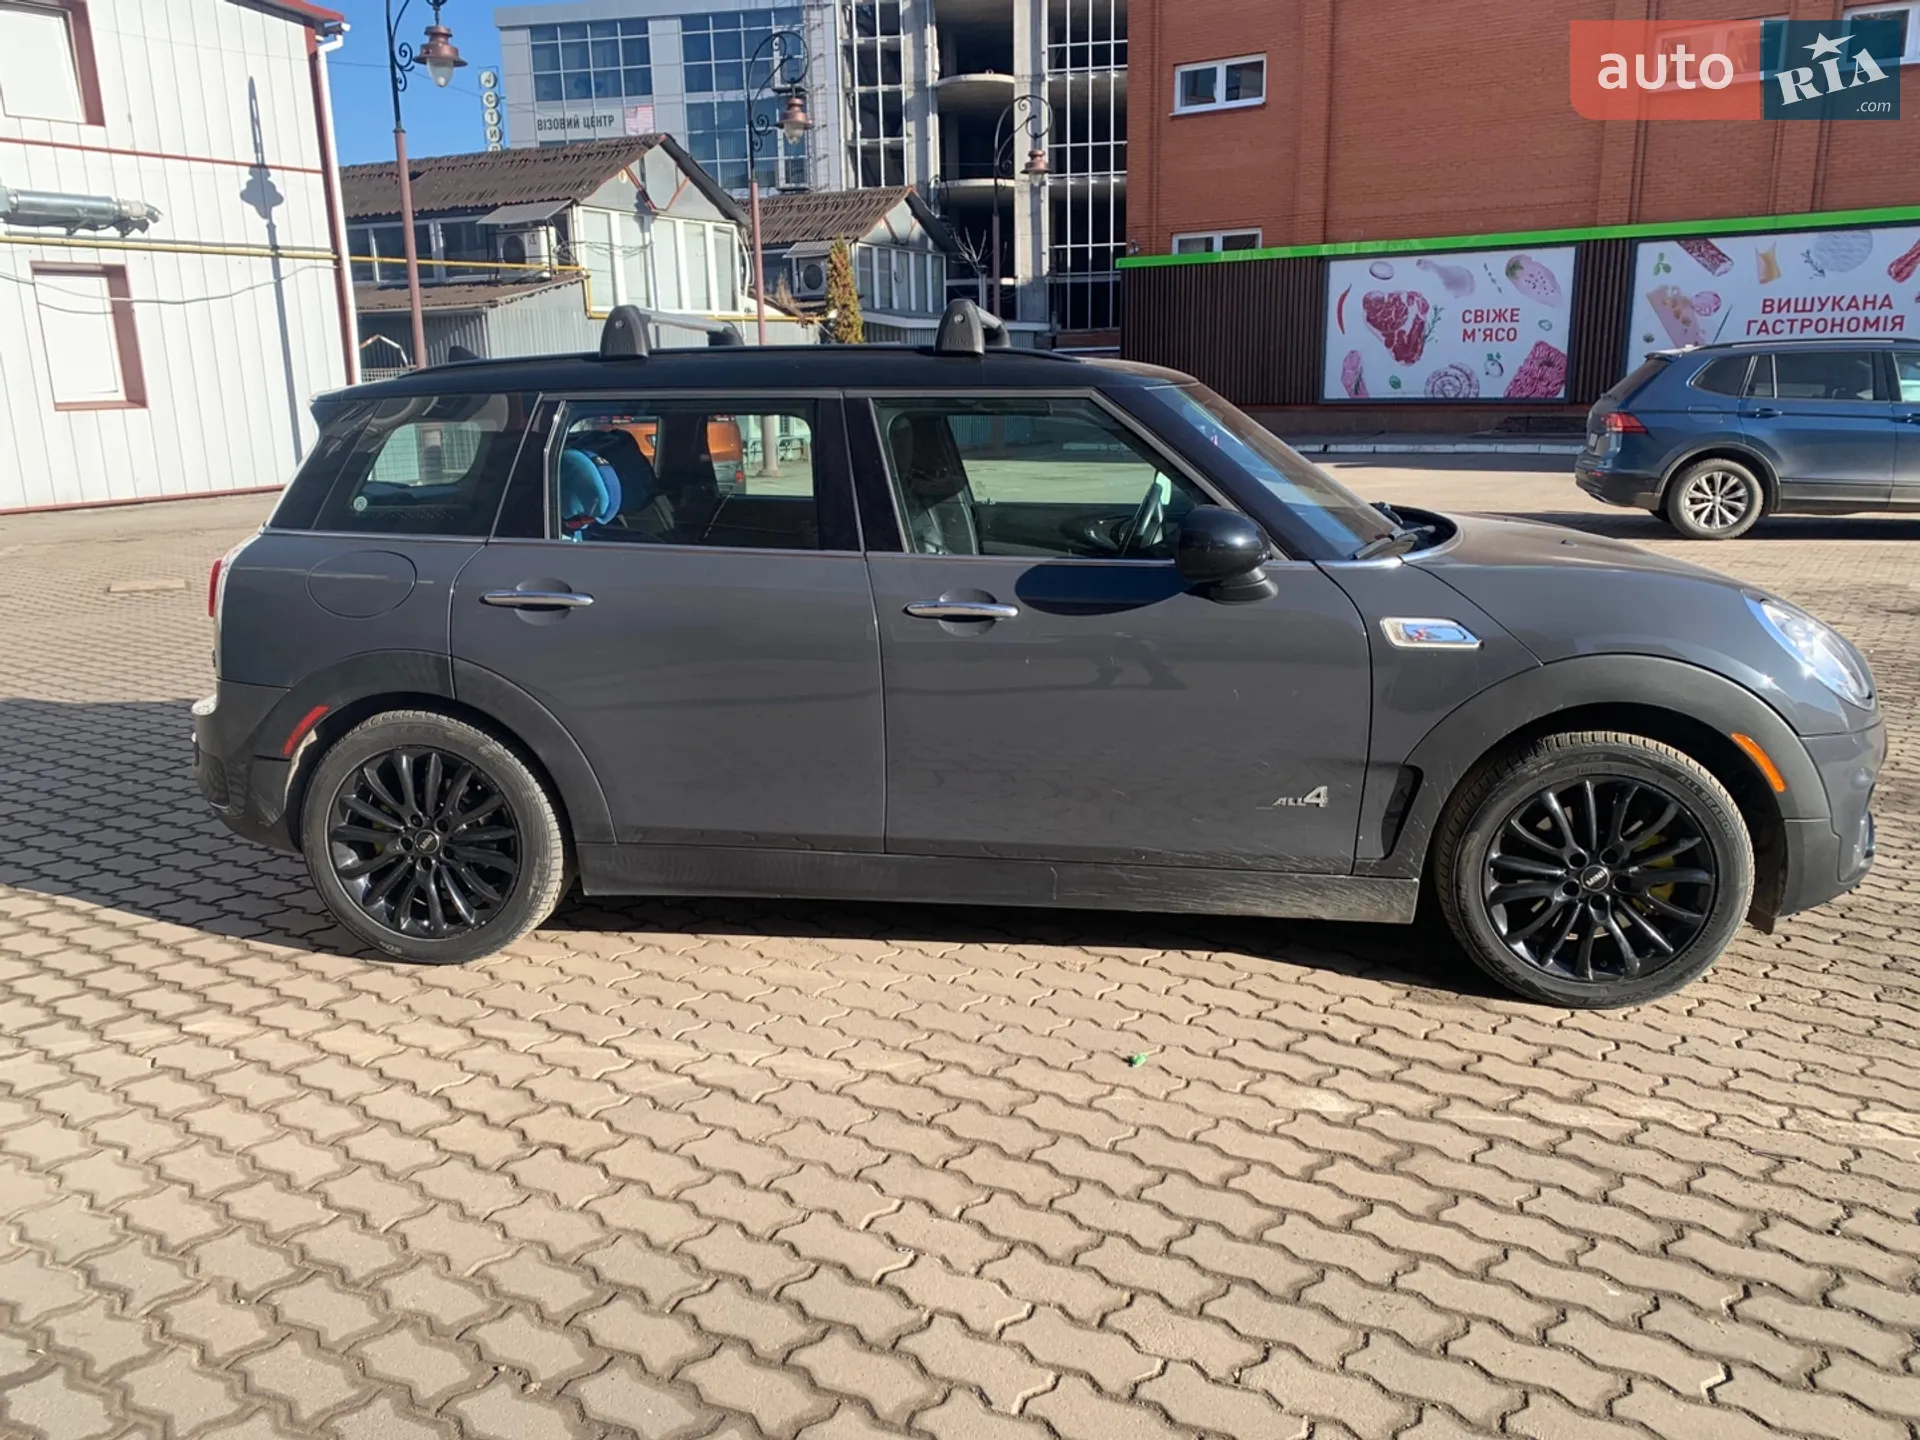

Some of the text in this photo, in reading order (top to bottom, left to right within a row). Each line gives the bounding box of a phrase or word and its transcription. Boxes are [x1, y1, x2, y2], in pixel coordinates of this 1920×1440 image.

[537, 114, 615, 131] ВІЗОВИЙ ЦЕНТР
[1761, 293, 1894, 315] ВИШУКАНА
[1461, 307, 1520, 324] СВІЖЕ
[1746, 315, 1906, 336] ГАСТРОНОМІЯ
[1462, 327, 1518, 343] М'ЯСО
[1585, 870, 1606, 887] MINI
